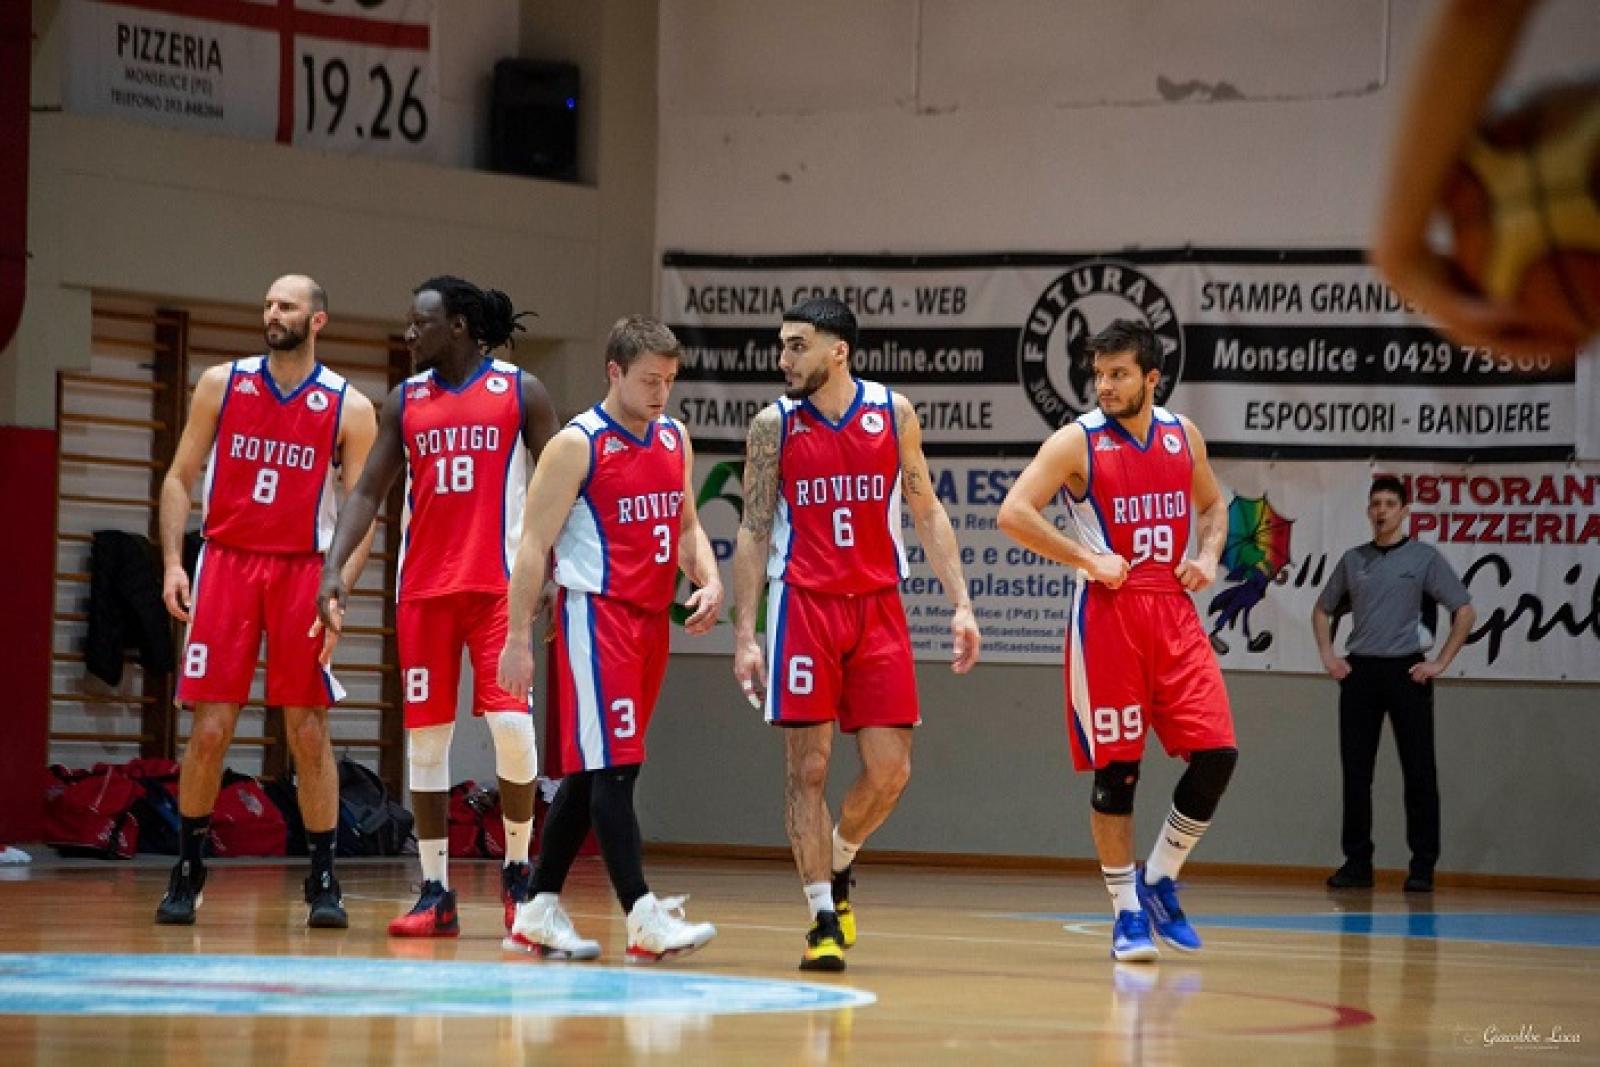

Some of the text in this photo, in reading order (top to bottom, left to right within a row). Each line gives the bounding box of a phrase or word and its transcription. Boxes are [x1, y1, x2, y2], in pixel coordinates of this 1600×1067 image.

[116, 22, 223, 73] PIZZERIA
[302, 54, 428, 143] 19.26
[685, 286, 785, 315] AGENZIA
[915, 286, 967, 315] WEB
[1023, 265, 1179, 363] FUTURAMA
[1200, 282, 1303, 314] STAMPA
[1213, 339, 1357, 373] Monselice
[1383, 341, 1452, 373] 0429
[914, 401, 993, 431] GITALE
[1245, 401, 1395, 433] ESPOSITORI
[1418, 402, 1552, 434] BANDIERE
[230, 433, 315, 470] ROVIGO
[415, 425, 499, 456] ROVIGO
[252, 468, 279, 504] 8
[434, 454, 475, 494] 18
[796, 474, 885, 506] ROVIGO
[1373, 473, 1600, 506] ISTORAN
[617, 490, 684, 523] ROVIG
[1113, 490, 1187, 524] ROVIGO
[652, 523, 670, 563] 3
[833, 507, 855, 547] 6
[1409, 512, 1600, 545] PIZZERIA
[1130, 524, 1173, 567] 99
[969, 573, 1077, 600] plastich
[183, 642, 208, 679] 8
[788, 655, 814, 695] 6
[611, 698, 636, 738] 3
[1094, 704, 1143, 744] 99
